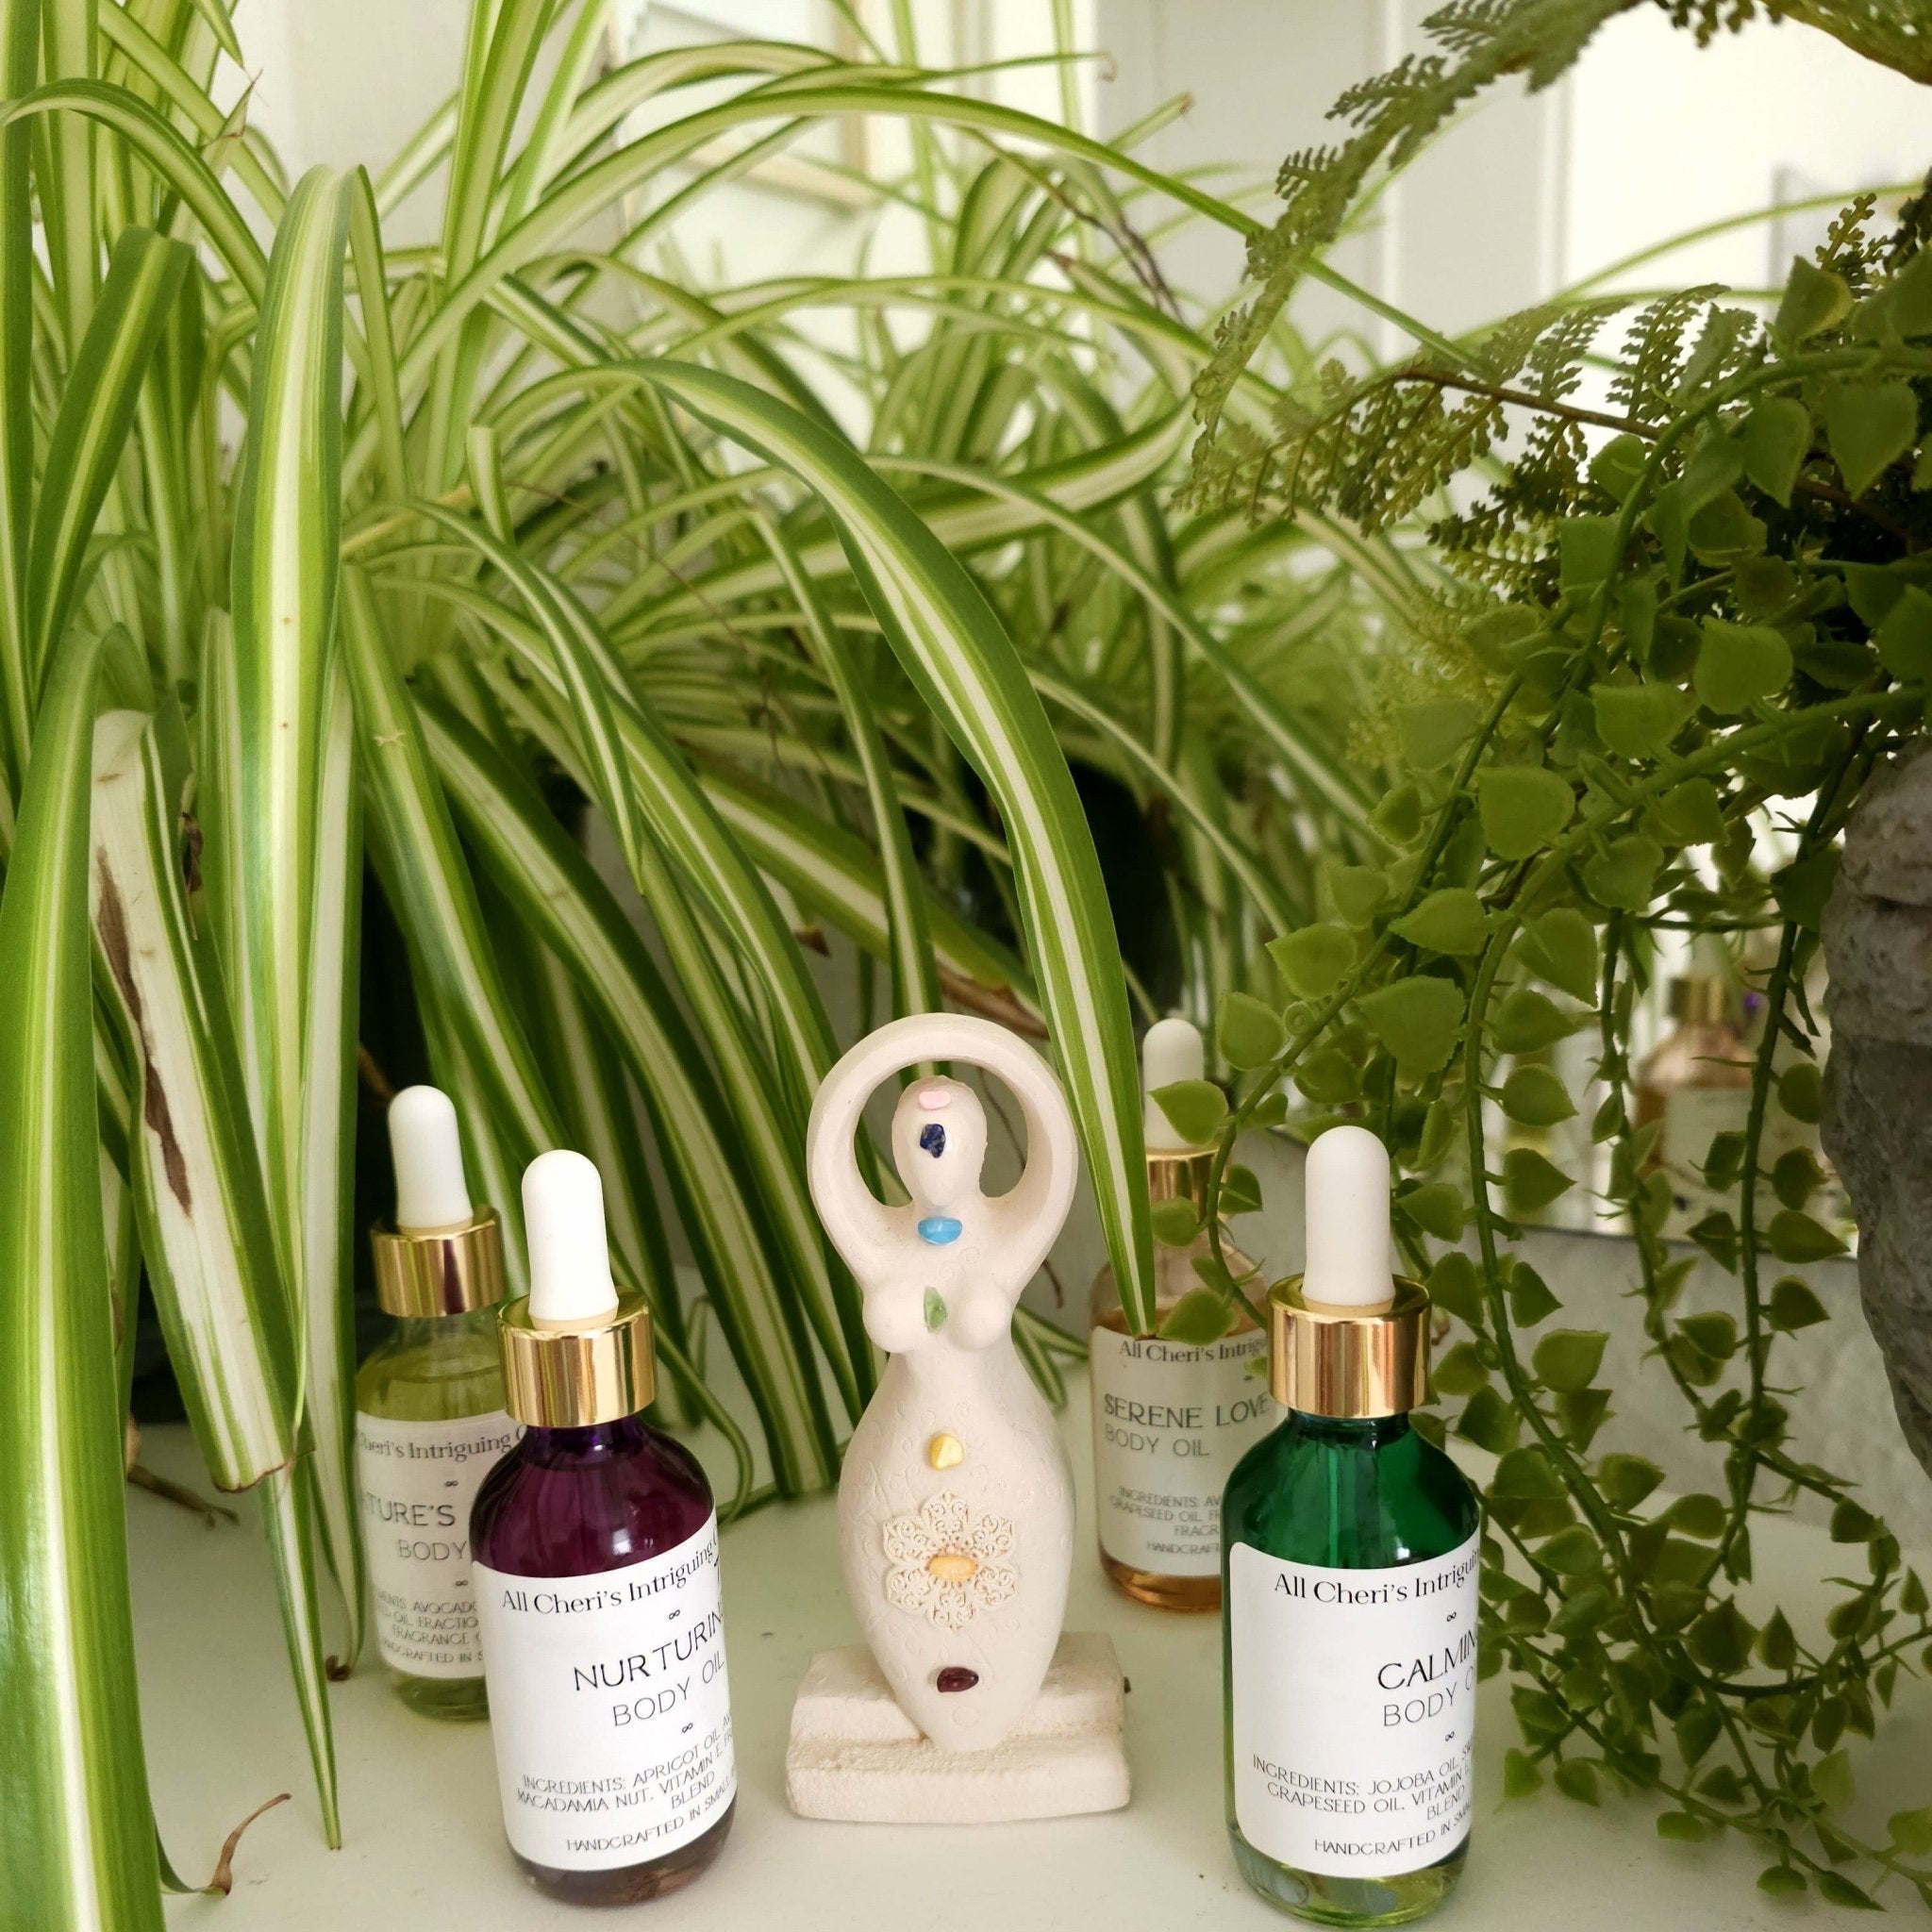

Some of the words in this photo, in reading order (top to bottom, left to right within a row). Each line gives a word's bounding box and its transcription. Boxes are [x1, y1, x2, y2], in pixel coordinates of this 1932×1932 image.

[1120, 1341, 1141, 1358] All
[1146, 1345, 1214, 1362] Cheri's
[1105, 1393, 1204, 1428] SERENE
[1216, 1391, 1270, 1426] LOVE
[408, 1435, 512, 1462] Intriguing
[1105, 1424, 1159, 1454] BODY
[1173, 1439, 1210, 1457] OIL
[398, 1540, 468, 1560] BODY
[501, 1590, 528, 1612] All
[534, 1590, 623, 1615] Cheri's
[629, 1541, 713, 1602] Intriguing
[1274, 1574, 1306, 1599] All
[1314, 1581, 1407, 1605] Cheri's
[392, 1624, 469, 1644] FRAGRANCE
[574, 1604, 723, 1690] NURTURIN
[1377, 1626, 1476, 1690] CALMIN
[613, 1676, 691, 1727] BODY
[702, 1650, 724, 1684] OIL
[1384, 1682, 1457, 1726] BODY
[517, 1788, 609, 1812] MACADAMIA
[659, 1752, 713, 1794] VITAMIN
[524, 1774, 625, 1794] INGREDIENTS:
[633, 1743, 699, 1787] APRICOT
[1253, 1754, 1359, 1795] INGREDIENTS:
[1368, 1770, 1435, 1795] JOJOBA
[671, 1771, 715, 1809] BLEND
[1267, 1782, 1366, 1813] GRAPESEED
[1411, 1767, 1462, 1806] VITAMIN
[1425, 1784, 1465, 1821] BLEND
[566, 1816, 684, 1851] HANDCRAFTED
[690, 1805, 701, 1821] IN
[1314, 1829, 1436, 1855] HANDCRAFTED
[1441, 1820, 1451, 1836] IN
